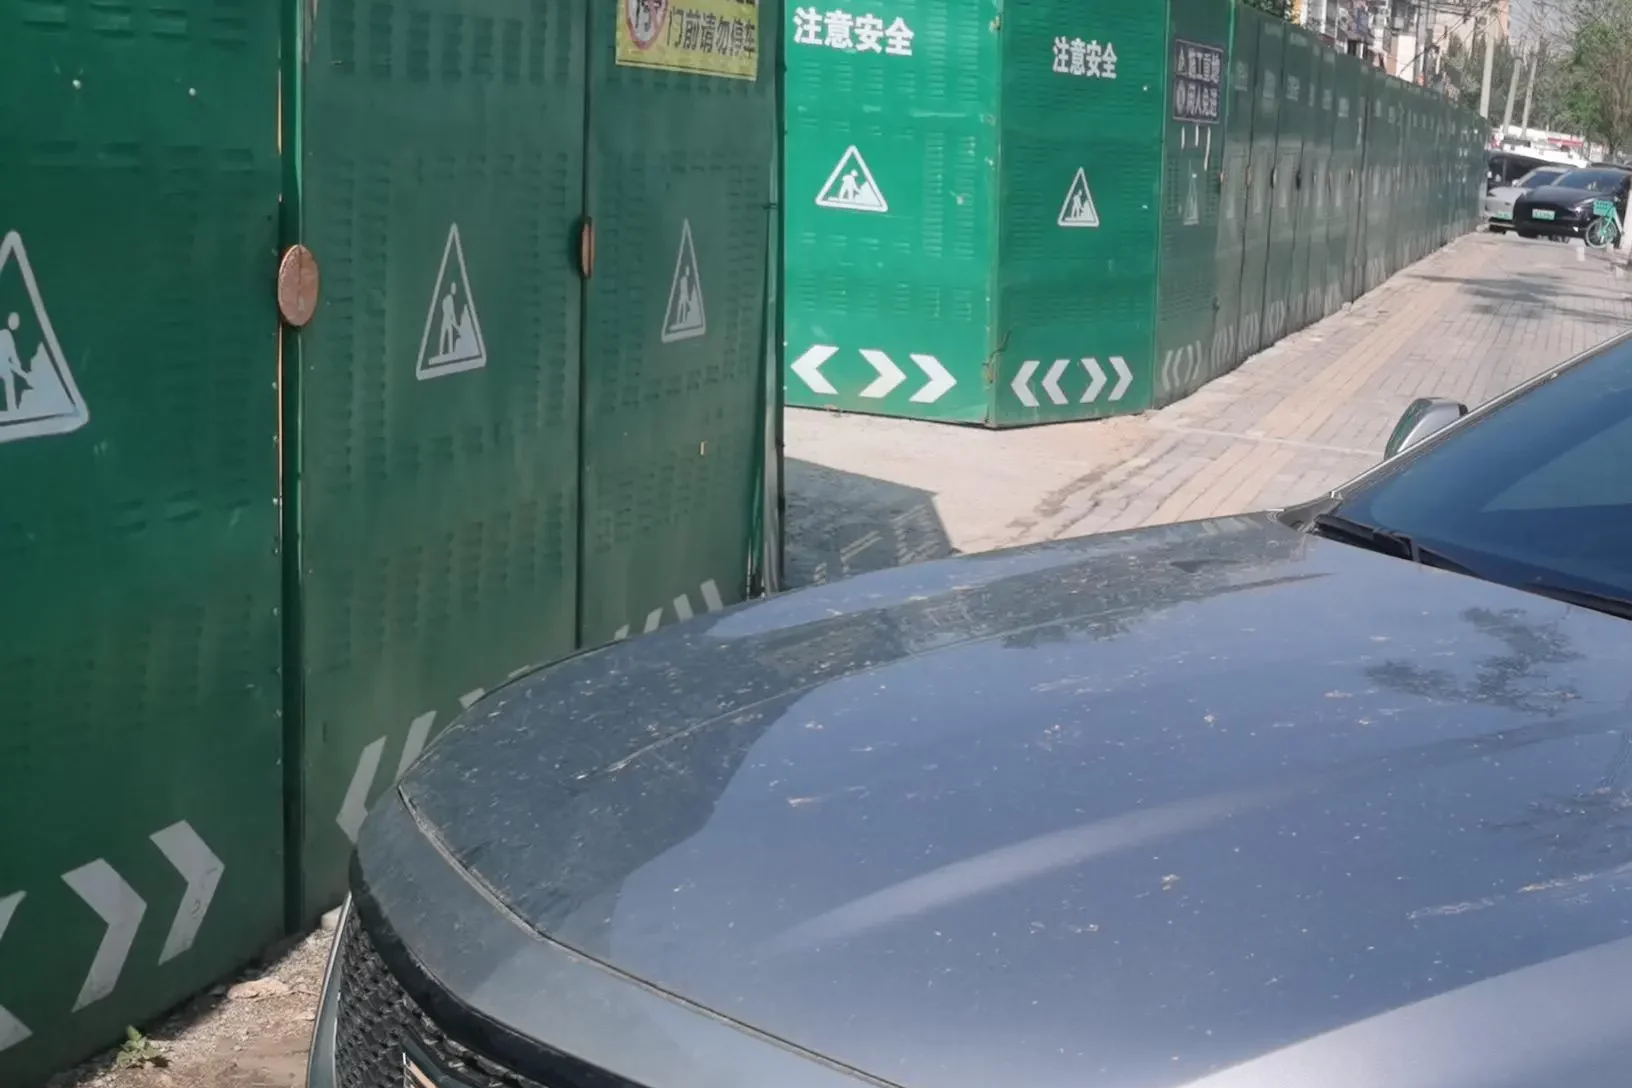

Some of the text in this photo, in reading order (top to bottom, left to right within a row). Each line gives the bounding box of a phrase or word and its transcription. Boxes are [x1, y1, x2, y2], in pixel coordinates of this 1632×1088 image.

[666, 6, 756, 57] 门前请勿停车
[793, 6, 915, 56] 注意安全
[1053, 36, 1117, 79] 注意安全
